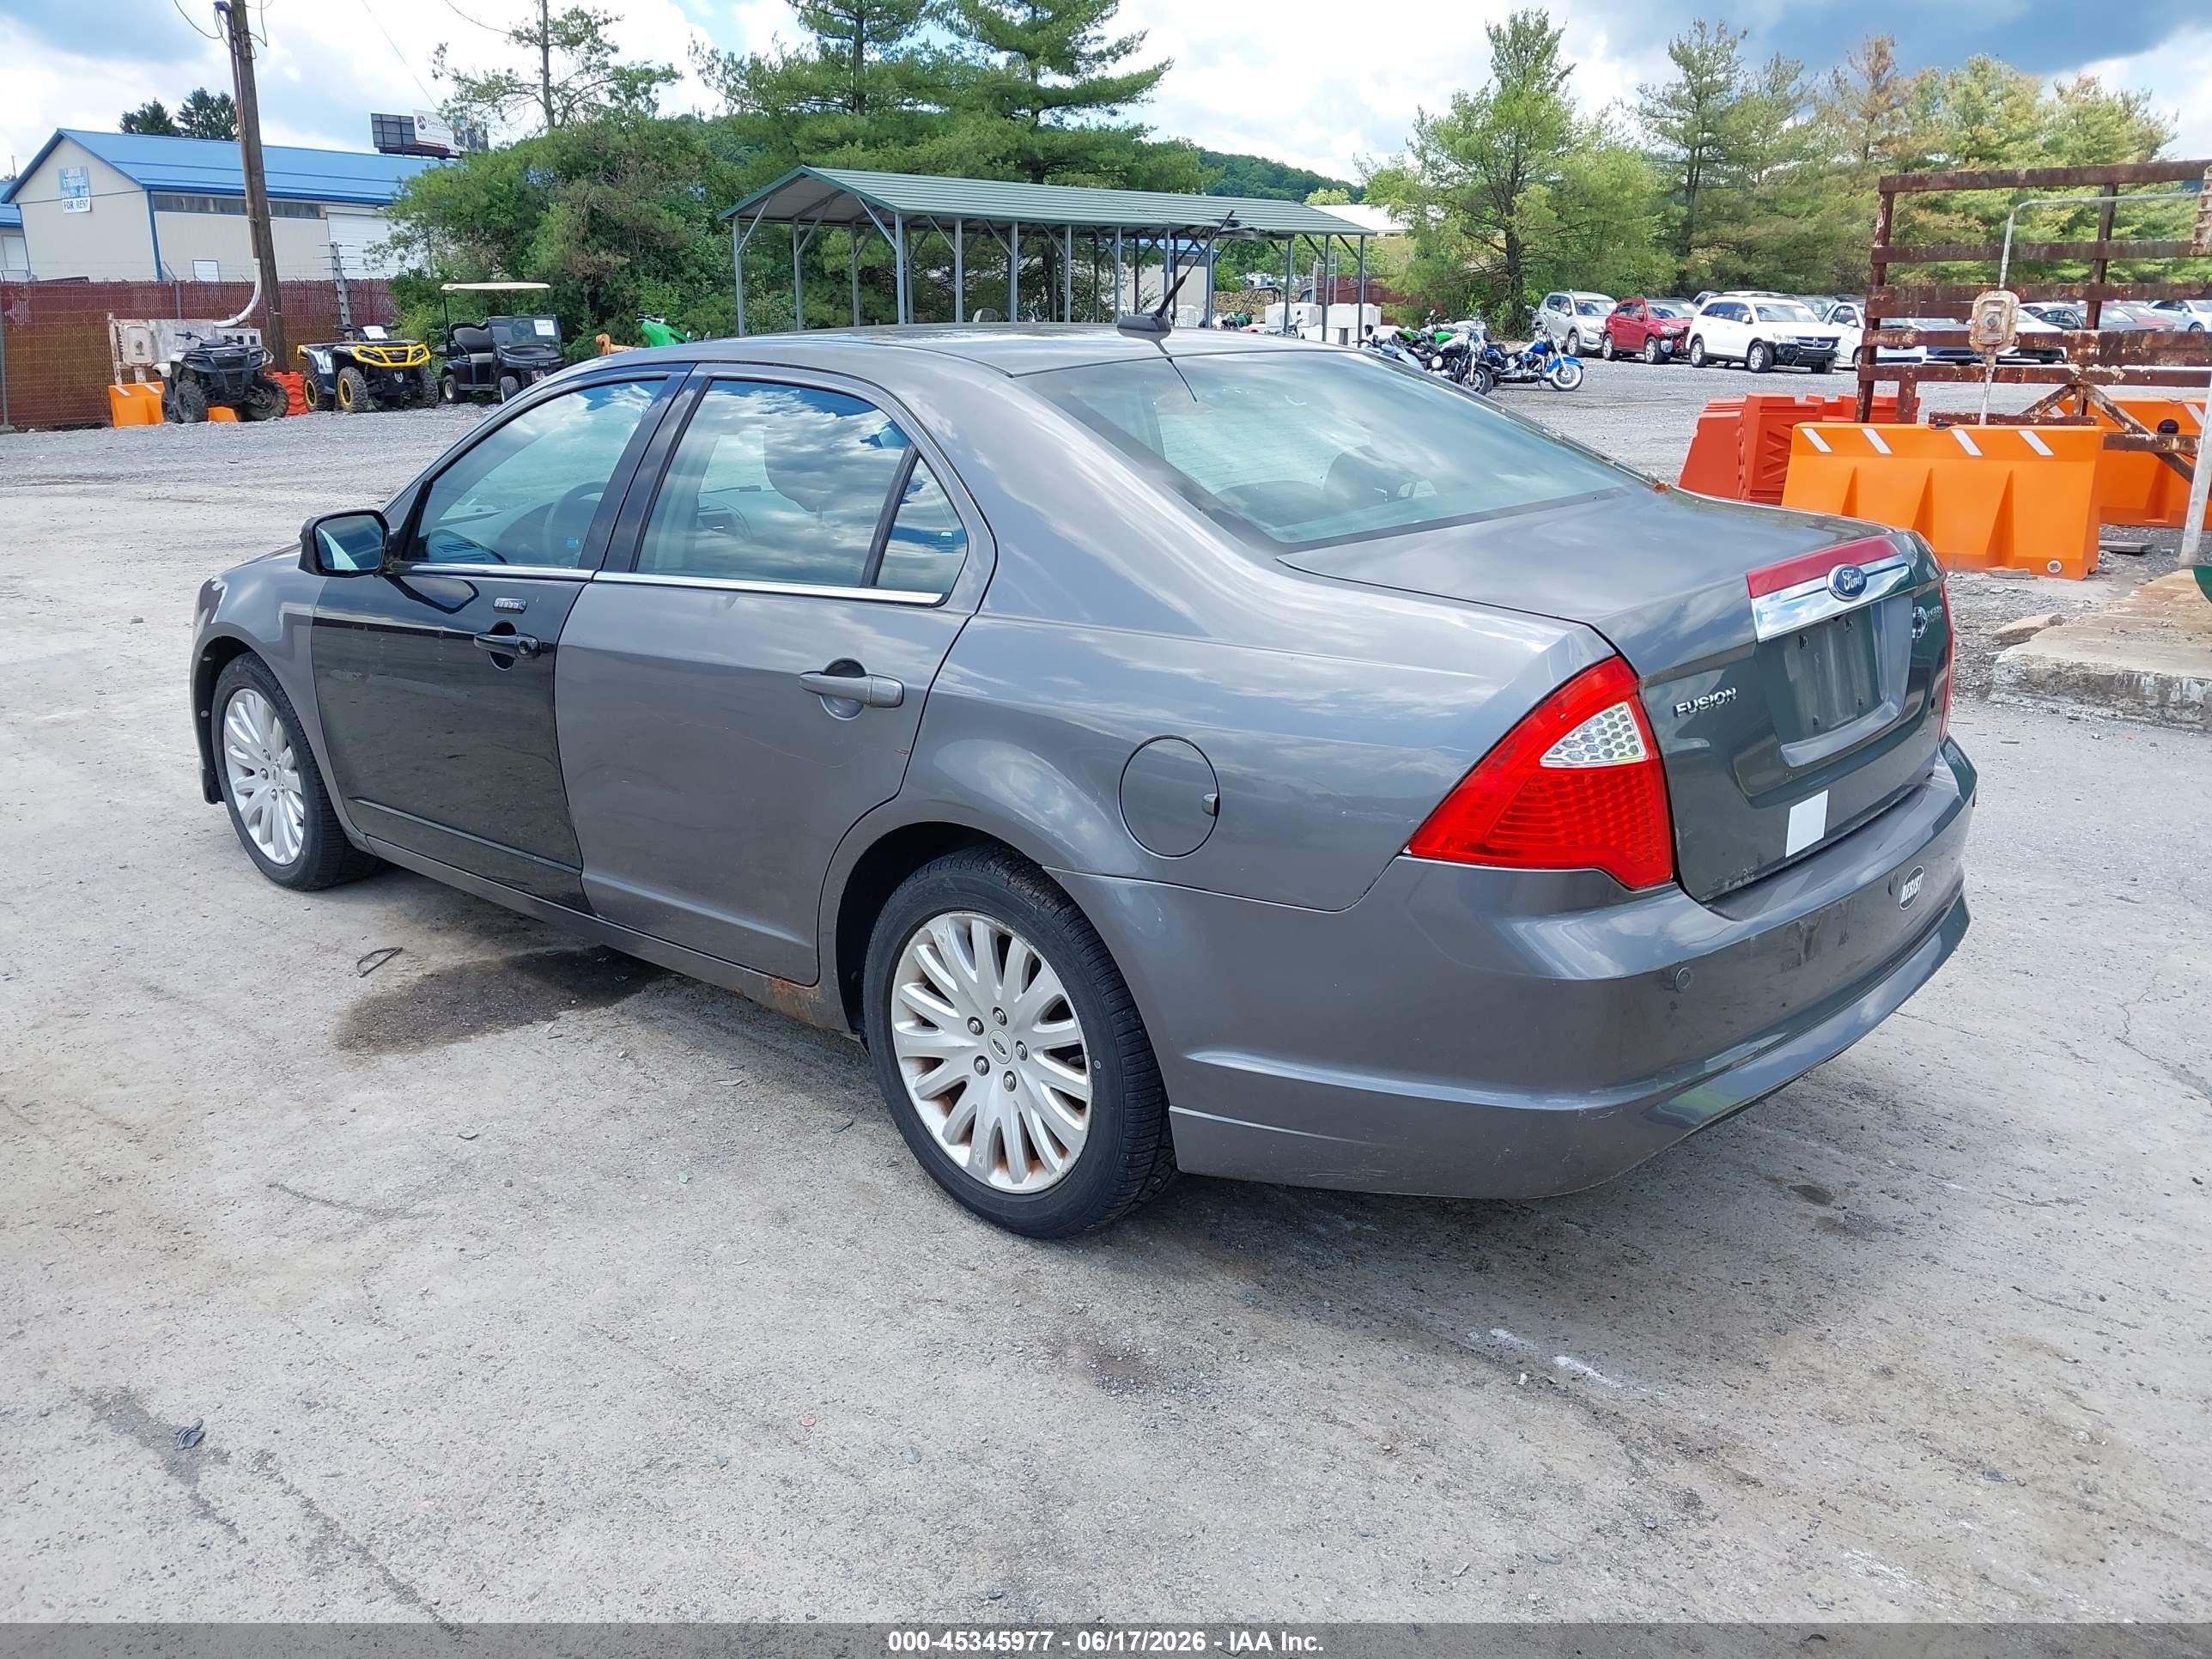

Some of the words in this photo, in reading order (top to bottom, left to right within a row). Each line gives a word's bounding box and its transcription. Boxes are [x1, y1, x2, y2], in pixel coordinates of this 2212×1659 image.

[63, 199, 75, 210] FOR
[1841, 568, 1863, 591] Ford
[1674, 687, 1737, 718] FUSION
[1899, 872, 1924, 903] RESIST
